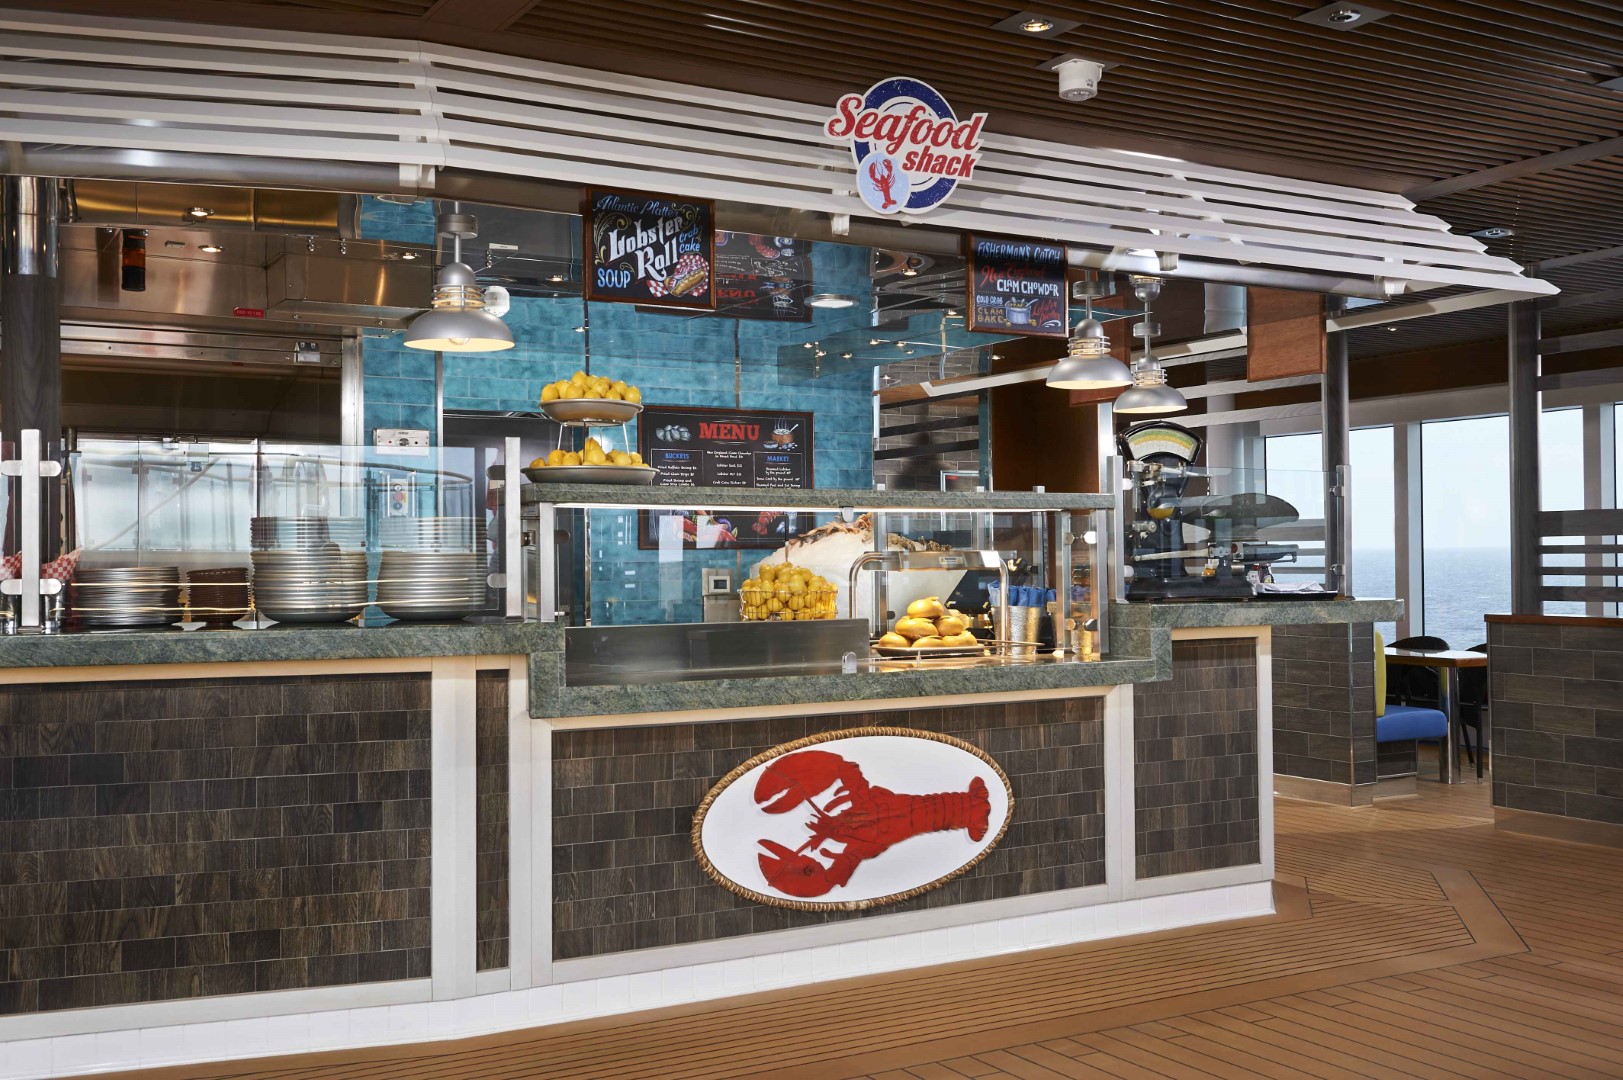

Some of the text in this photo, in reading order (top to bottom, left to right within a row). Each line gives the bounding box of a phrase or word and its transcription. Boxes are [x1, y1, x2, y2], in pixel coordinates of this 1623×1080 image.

[828, 96, 983, 155] Seafood
[902, 146, 976, 178] shack
[592, 195, 679, 218] Atlantic Platter
[607, 216, 684, 262] Lobster
[635, 239, 678, 281] Roll
[598, 268, 631, 288] SOUP
[996, 279, 1060, 297] CLAM CHOWDER
[977, 307, 1004, 315] CLAM
[977, 315, 1004, 324] BAKE
[699, 422, 760, 440] MENU
